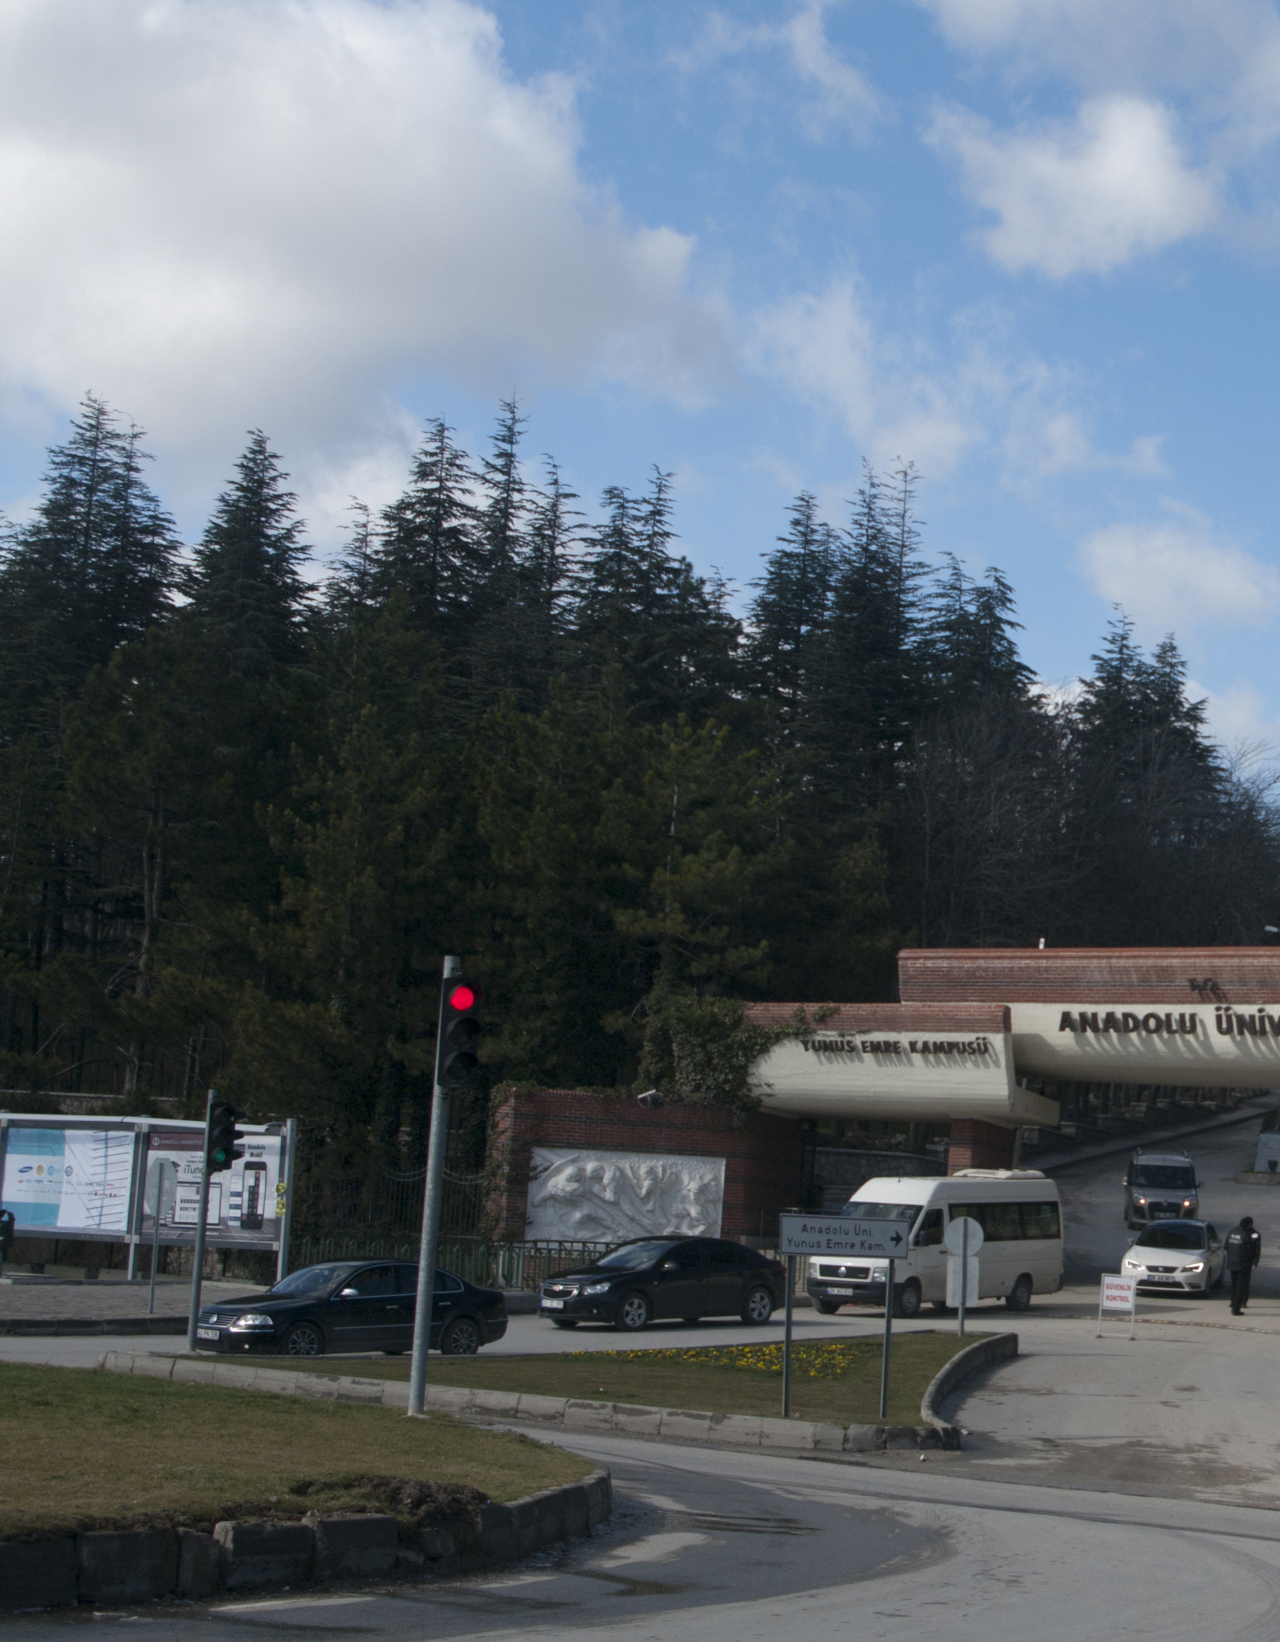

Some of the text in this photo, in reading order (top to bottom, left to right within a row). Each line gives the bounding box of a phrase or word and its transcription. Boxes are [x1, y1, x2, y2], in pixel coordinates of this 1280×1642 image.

[1058, 1010, 1198, 1035] ANADOLU
[800, 1039, 854, 1053] YUNUS
[861, 1040, 902, 1054] EMRE
[801, 1223, 850, 1235] Anadolu
[786, 1237, 886, 1251] Yunus Emre Kam.
[1105, 1282, 1132, 1291] GÜVENLİK
[1105, 1295, 1130, 1303] KONTROL
